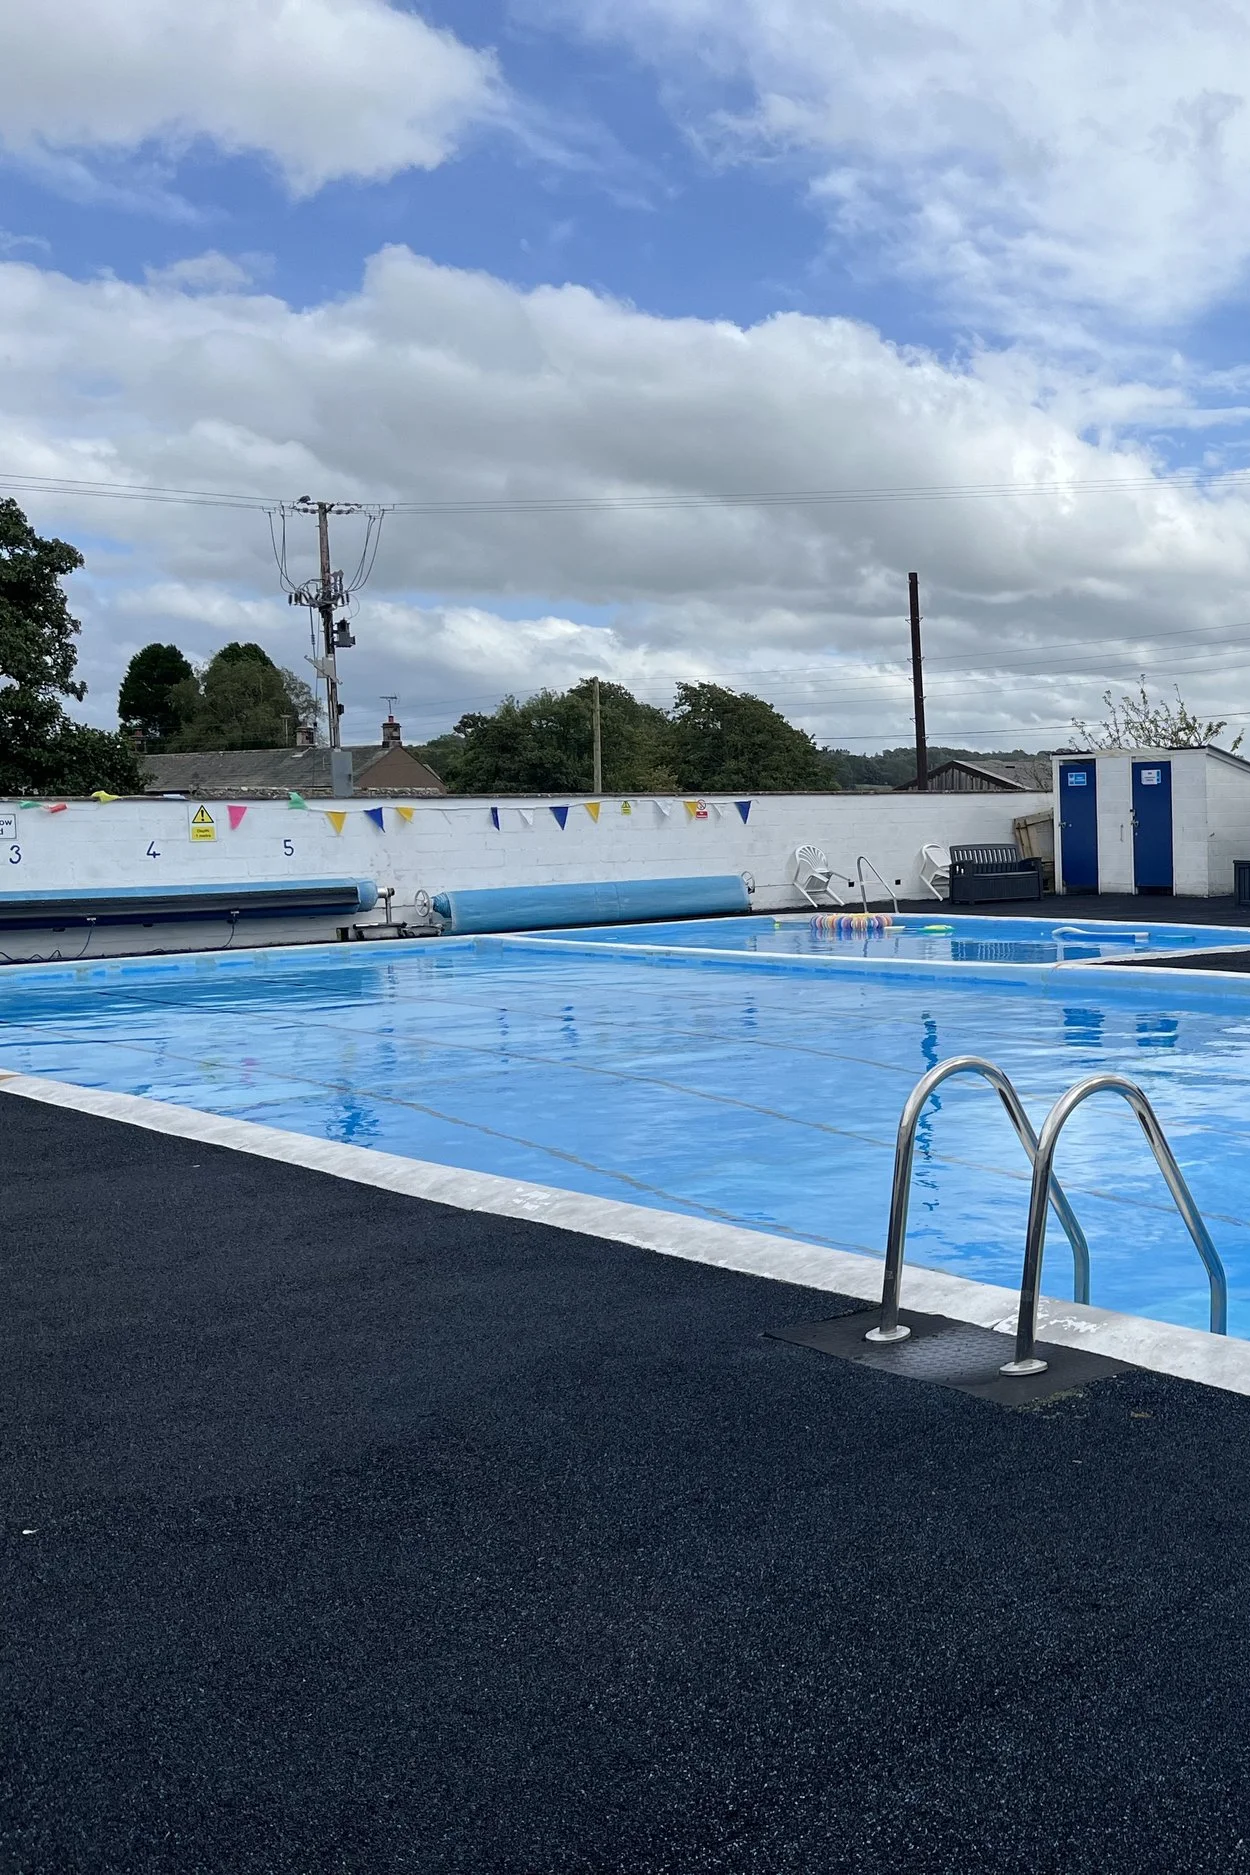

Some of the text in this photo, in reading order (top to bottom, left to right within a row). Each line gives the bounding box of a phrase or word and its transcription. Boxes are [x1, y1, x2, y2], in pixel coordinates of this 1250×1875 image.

[9, 844, 22, 865] 3
[146, 841, 161, 859] 4
[283, 839, 294, 856] 5
